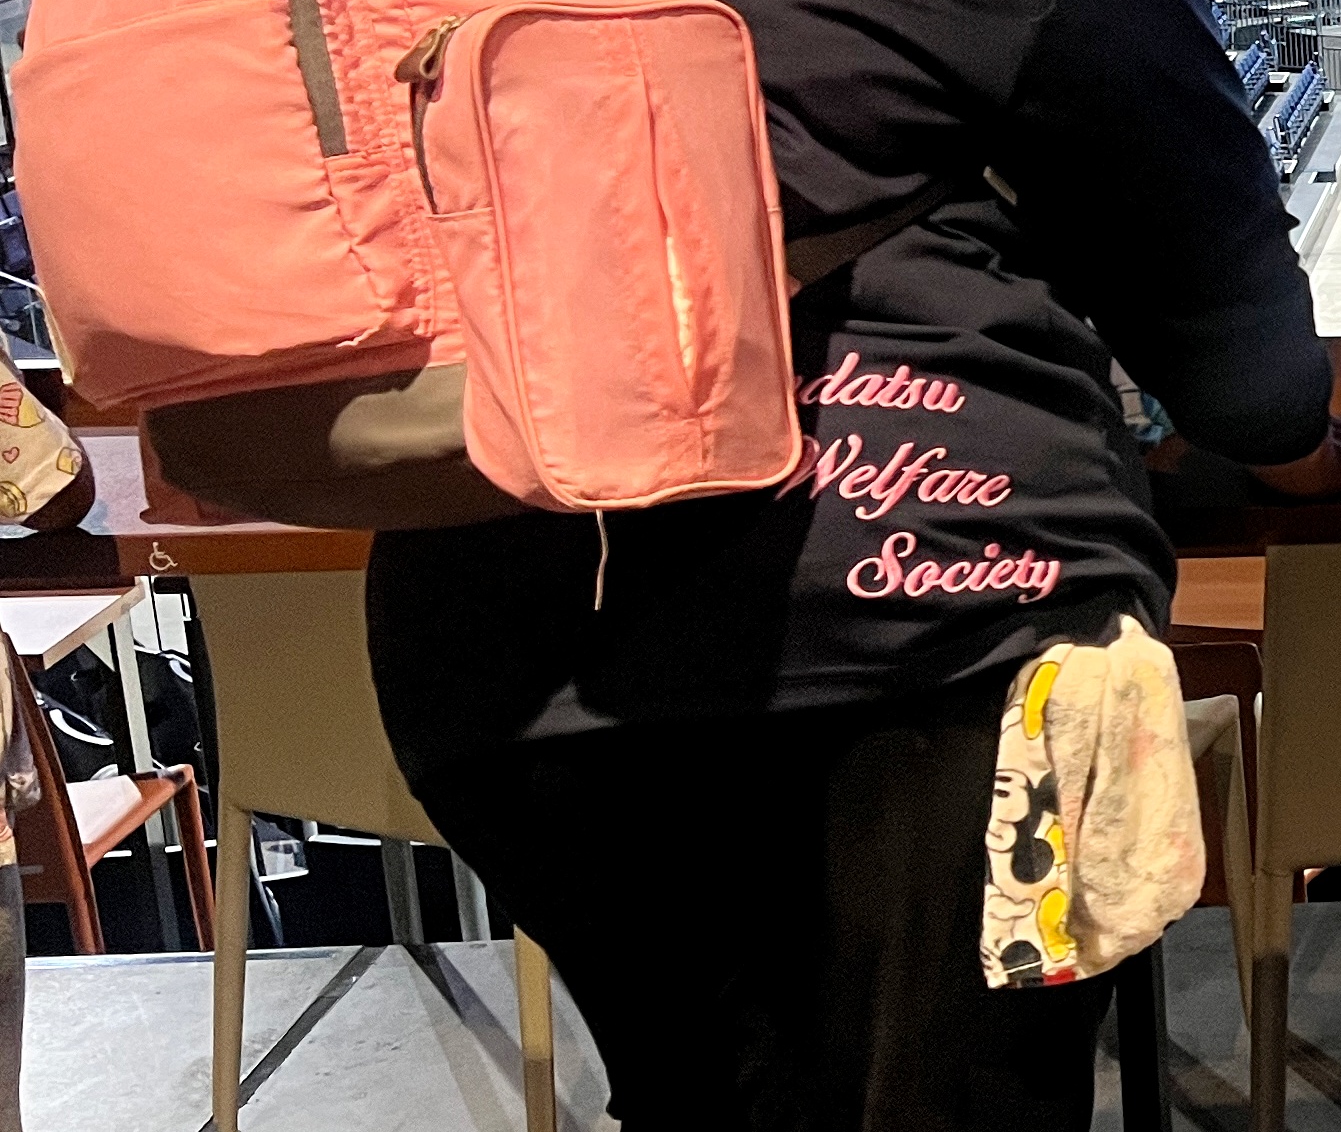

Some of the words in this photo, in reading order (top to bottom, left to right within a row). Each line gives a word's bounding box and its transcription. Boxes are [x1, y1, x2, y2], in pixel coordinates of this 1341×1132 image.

[796, 352, 966, 413] datsu
[777, 434, 1013, 520] Welfare
[846, 531, 1061, 604] Society
